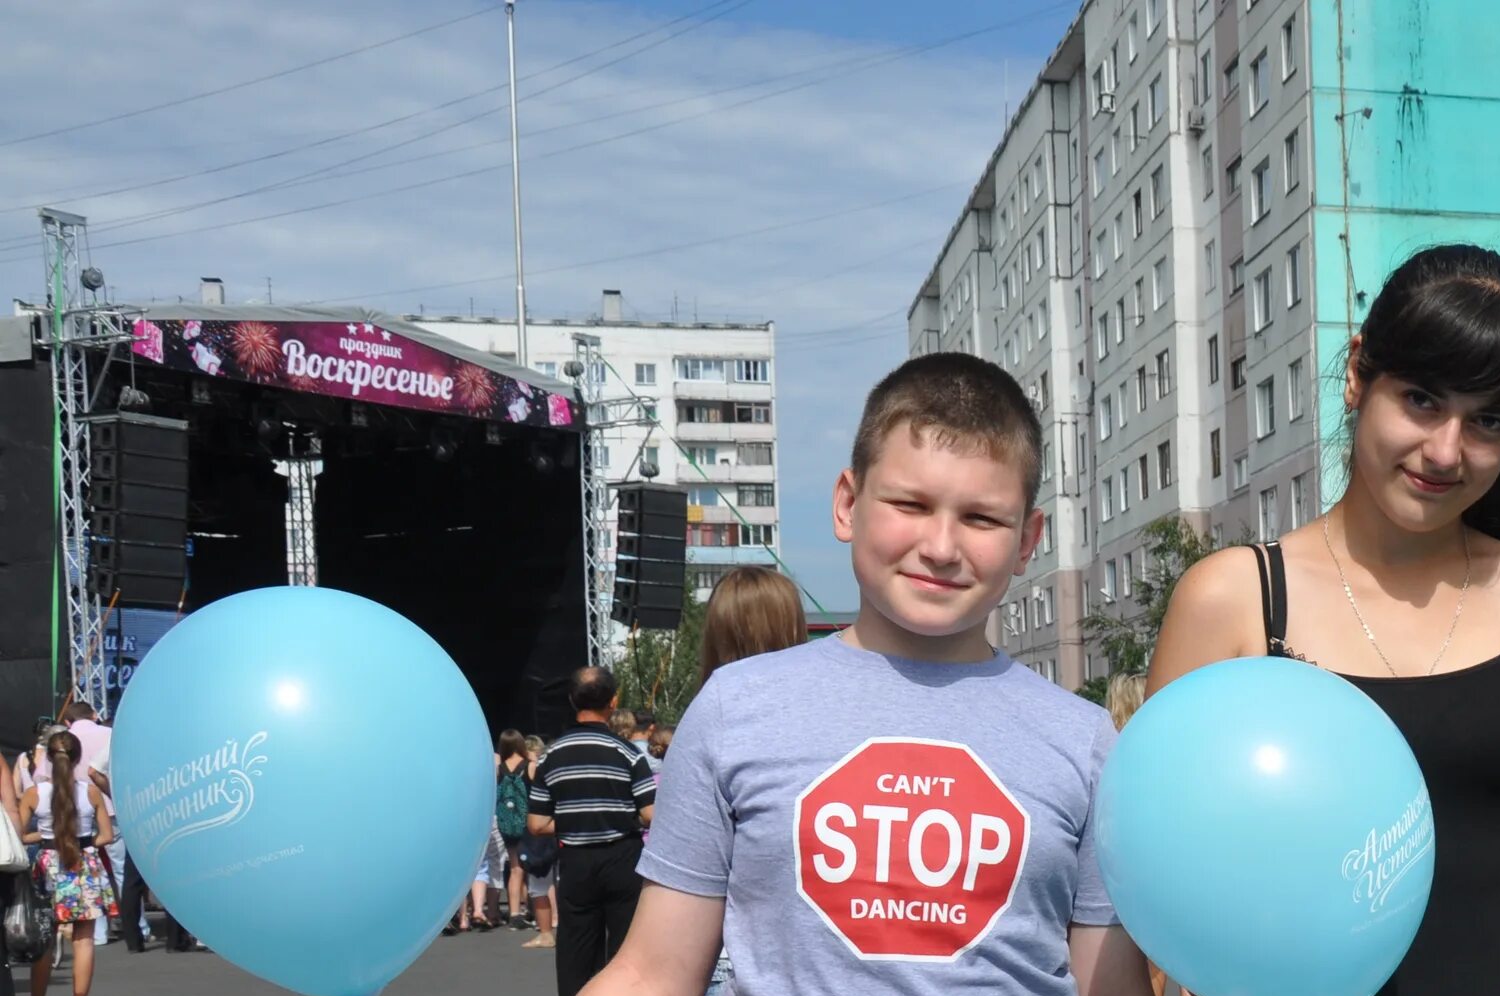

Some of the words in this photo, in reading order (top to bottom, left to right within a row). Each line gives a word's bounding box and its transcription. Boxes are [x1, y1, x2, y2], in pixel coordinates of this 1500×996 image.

[339, 337, 402, 360] праздник
[282, 339, 454, 400] Воскресенье
[876, 773, 955, 797] CAN'T
[812, 801, 1011, 892] STOP
[850, 898, 967, 925] DANCING
